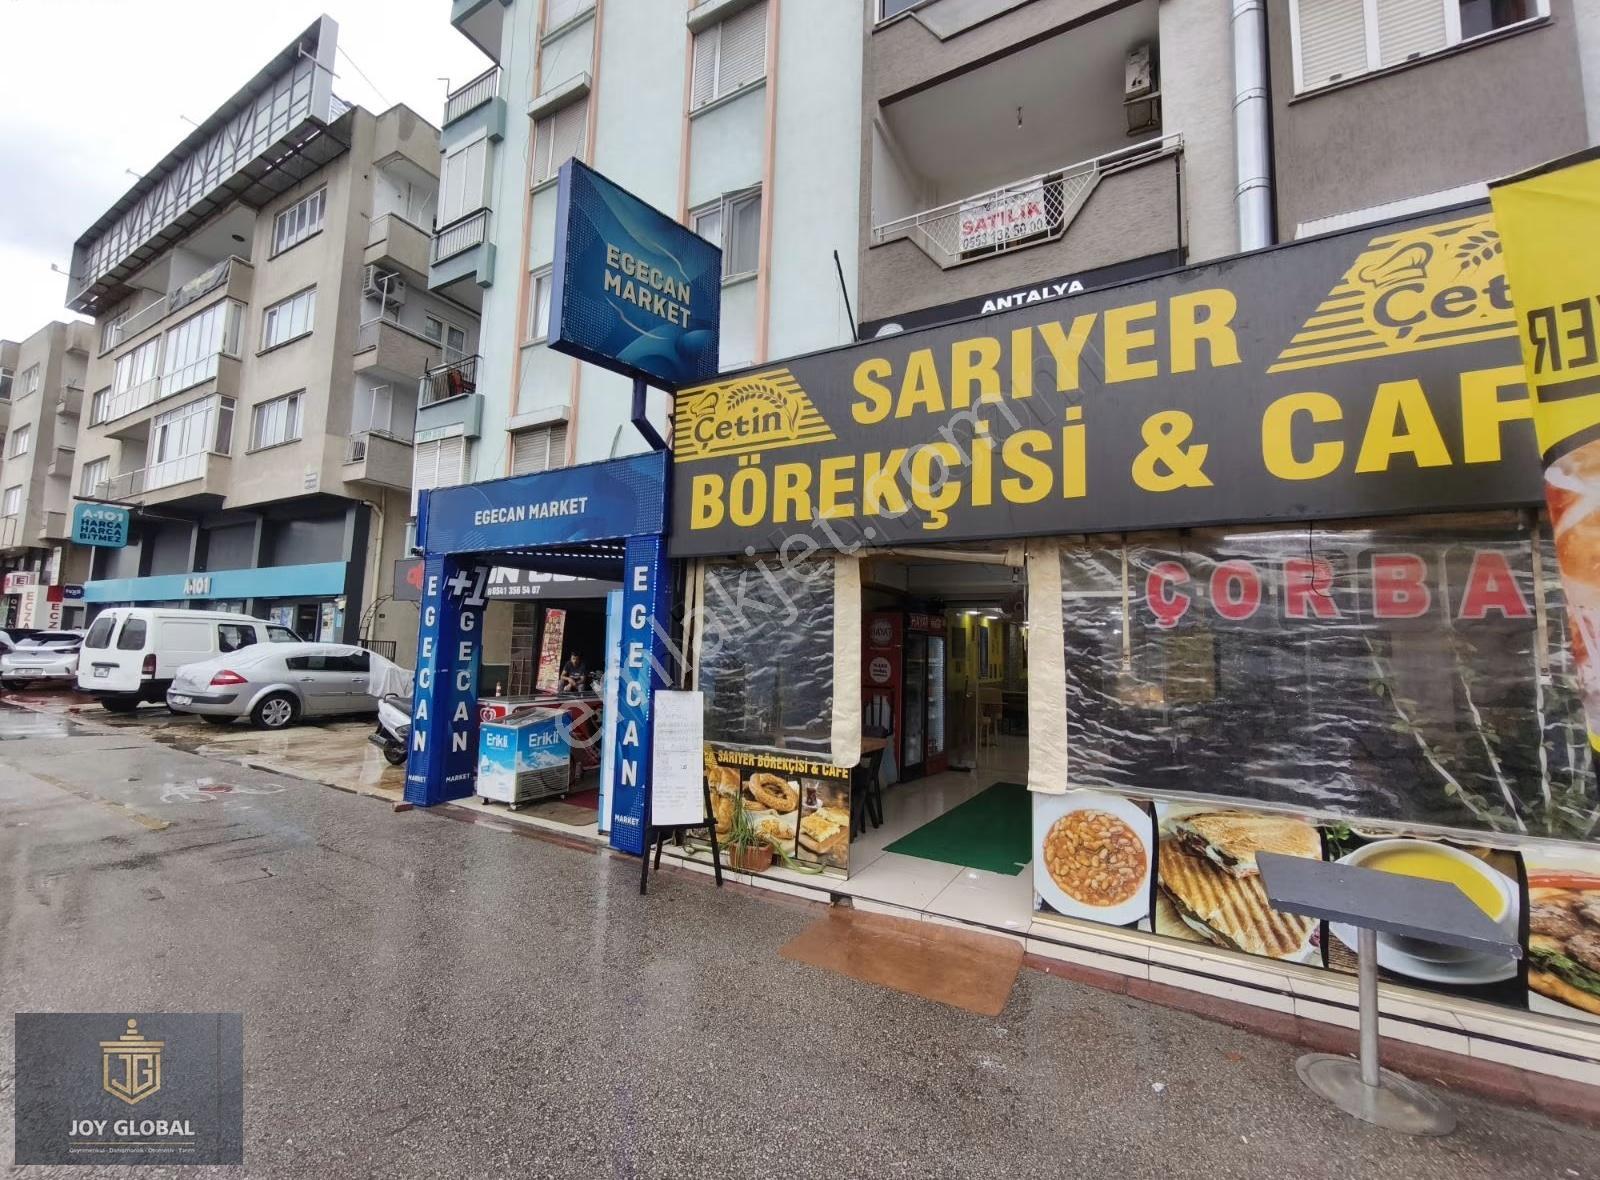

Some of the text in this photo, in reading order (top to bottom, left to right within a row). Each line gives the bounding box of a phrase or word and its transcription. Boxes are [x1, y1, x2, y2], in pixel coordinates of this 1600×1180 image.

[962, 201, 1042, 236] SATILIK
[606, 242, 691, 305] EGECAN
[603, 269, 692, 329] MARKET
[981, 280, 1084, 314] ANTALYA
[1373, 274, 1514, 339] Çet
[851, 288, 1242, 425] SARIYER
[690, 364, 1534, 530] BÖREKÇİSİ & CAF
[694, 410, 782, 450] Çetin
[81, 519, 122, 529] HARCA
[475, 496, 588, 526] EGECAN MARKET
[80, 526, 121, 536] HARCA
[1145, 549, 1534, 629] ÇORBA
[23, 591, 35, 630] ECZA
[47, 603, 60, 629] ECZ
[413, 575, 438, 753] EGECAN
[452, 611, 475, 753] GECAN
[621, 566, 649, 787] EGECAN
[486, 732, 508, 748] Erikli
[529, 730, 559, 748] Erikli
[446, 773, 471, 784] MARKET
[718, 750, 755, 767] SARIYER
[757, 752, 809, 775] BÖREKÇİSİ
[811, 761, 819, 775] &
[614, 813, 640, 826] MARKET
